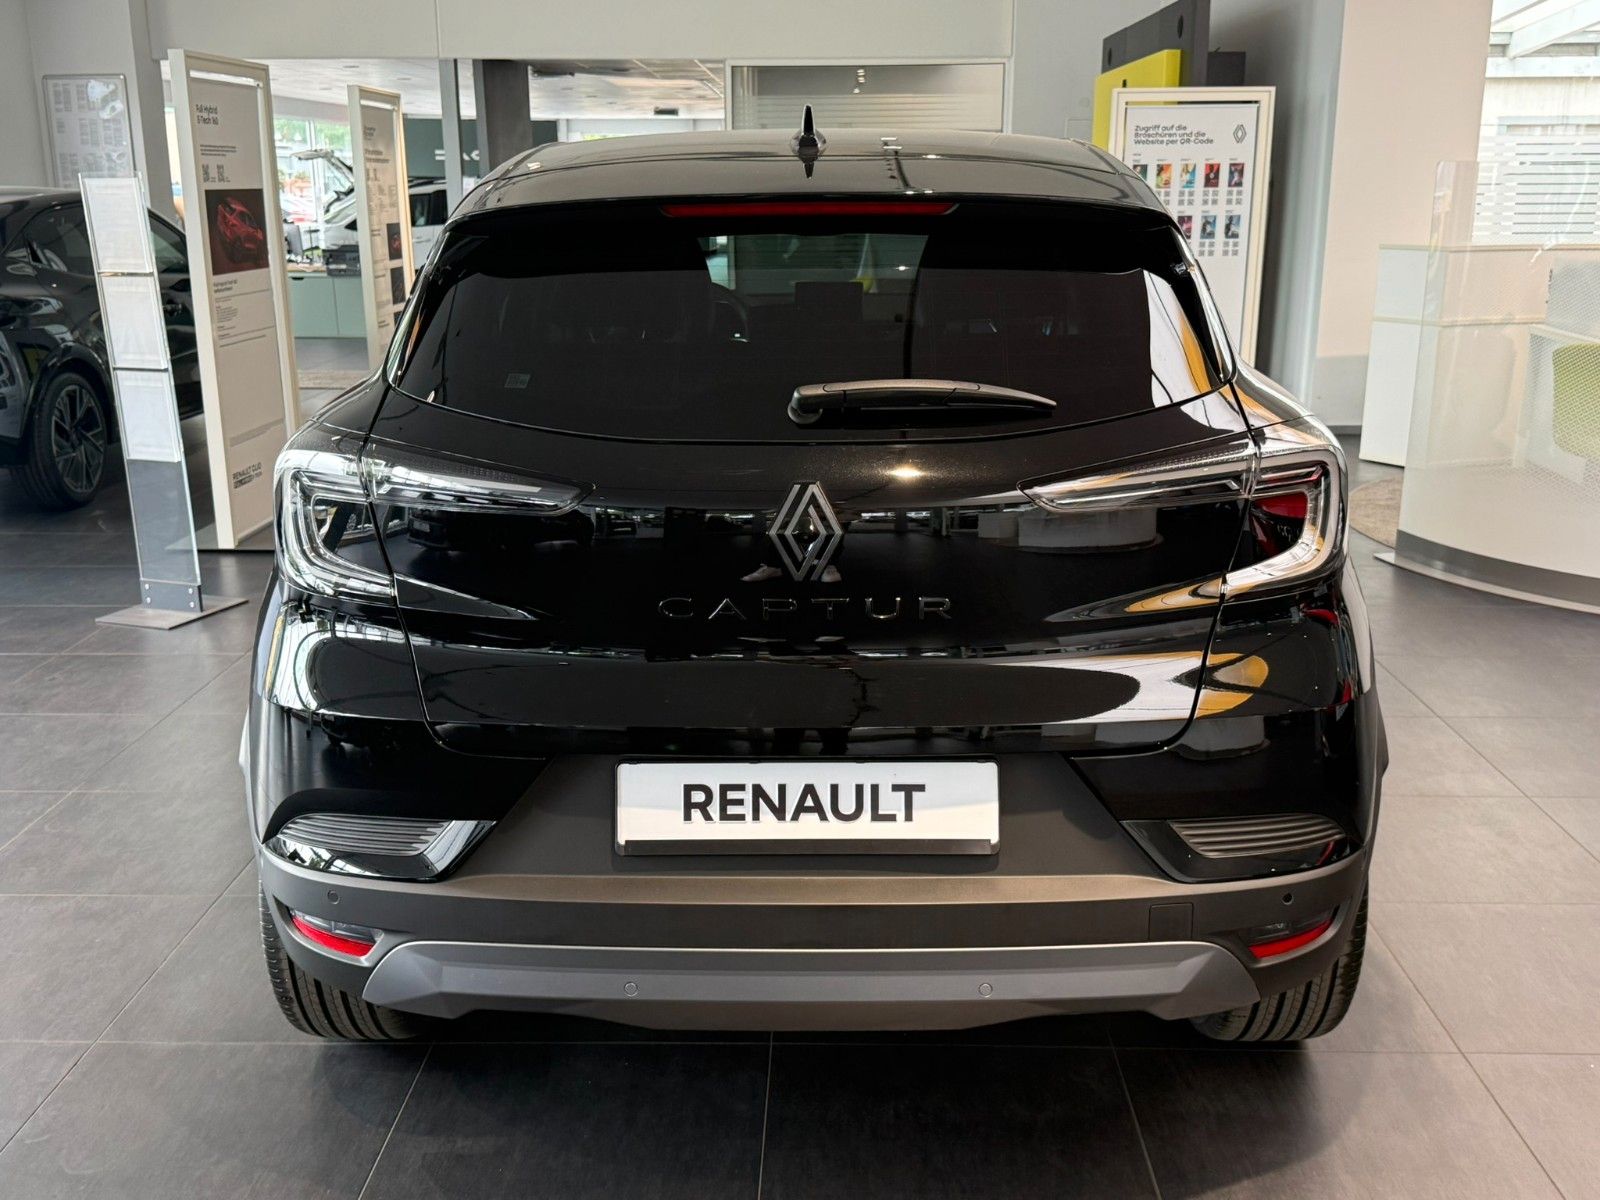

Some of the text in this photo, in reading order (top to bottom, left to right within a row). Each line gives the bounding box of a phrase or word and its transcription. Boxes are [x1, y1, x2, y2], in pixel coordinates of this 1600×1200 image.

[1135, 125, 1160, 133] Zugriff
[657, 596, 953, 620] CAPTUR
[682, 783, 926, 823] RENAULT
